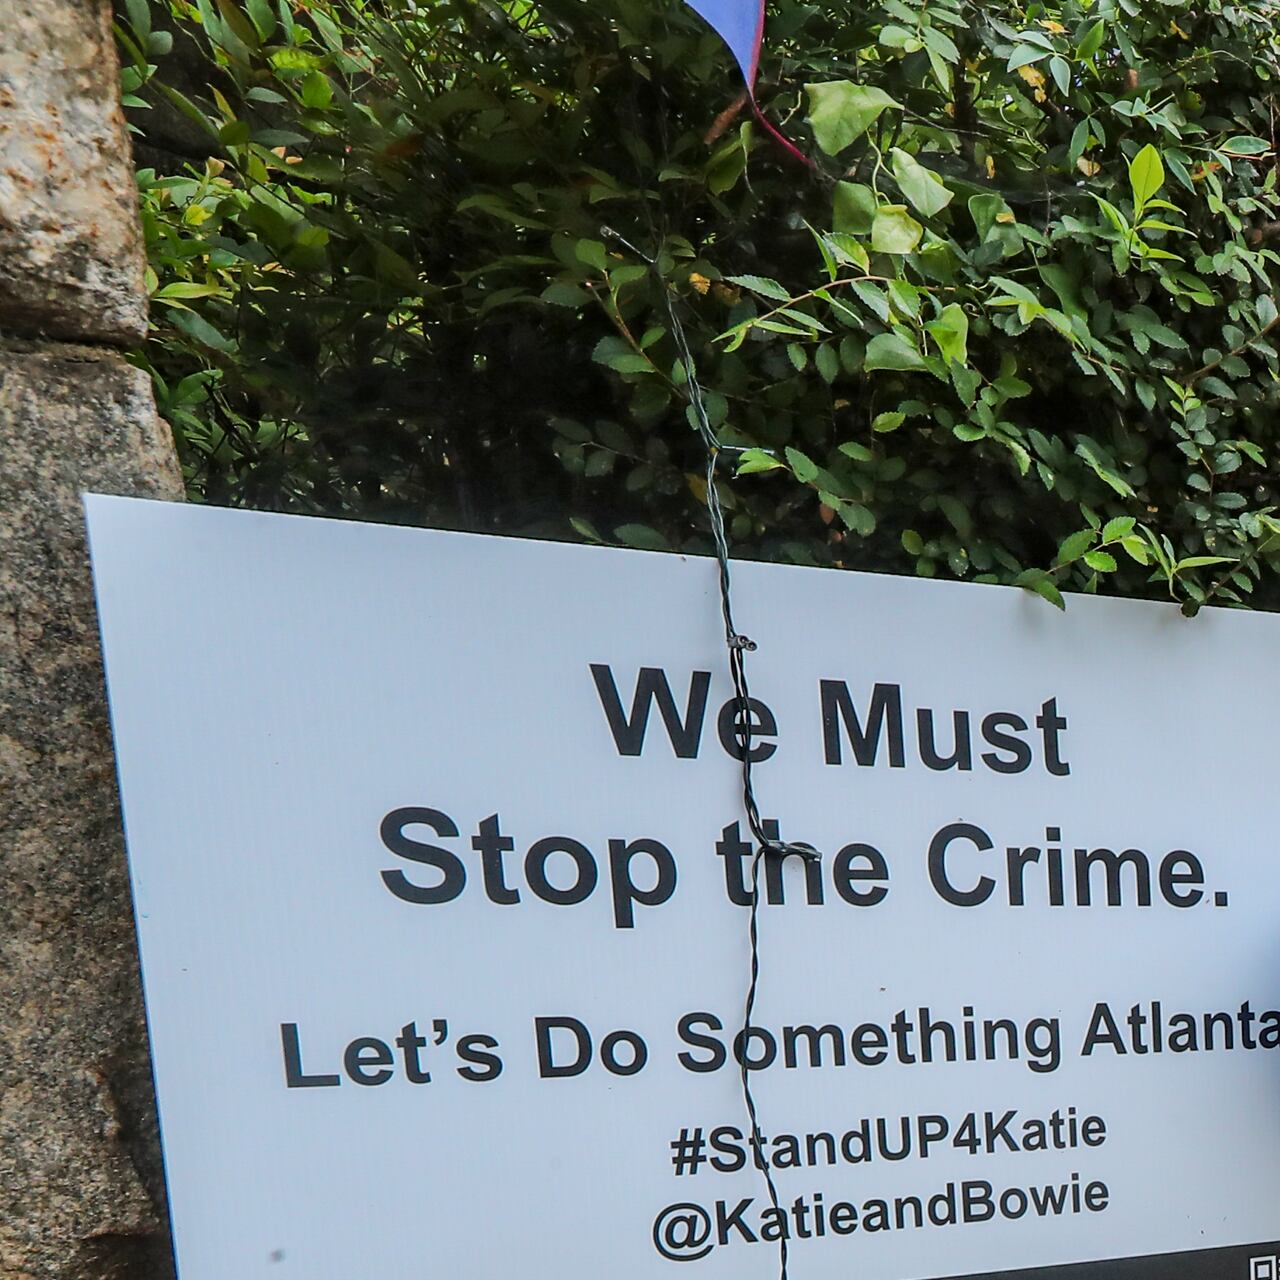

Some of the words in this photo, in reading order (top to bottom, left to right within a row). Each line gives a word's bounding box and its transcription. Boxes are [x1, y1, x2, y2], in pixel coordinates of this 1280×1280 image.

[590, 663, 778, 763] We
[820, 679, 1070, 776] Must
[380, 806, 677, 928] Stop
[715, 819, 889, 907] the
[928, 823, 1228, 908] Crime.
[281, 1019, 502, 1088] Let's
[535, 1016, 648, 1078] Do
[677, 1006, 1060, 1073] Something
[670, 1107, 1107, 1176] #StandUP4Katie
[652, 1172, 1110, 1262] @KatieandBowie
